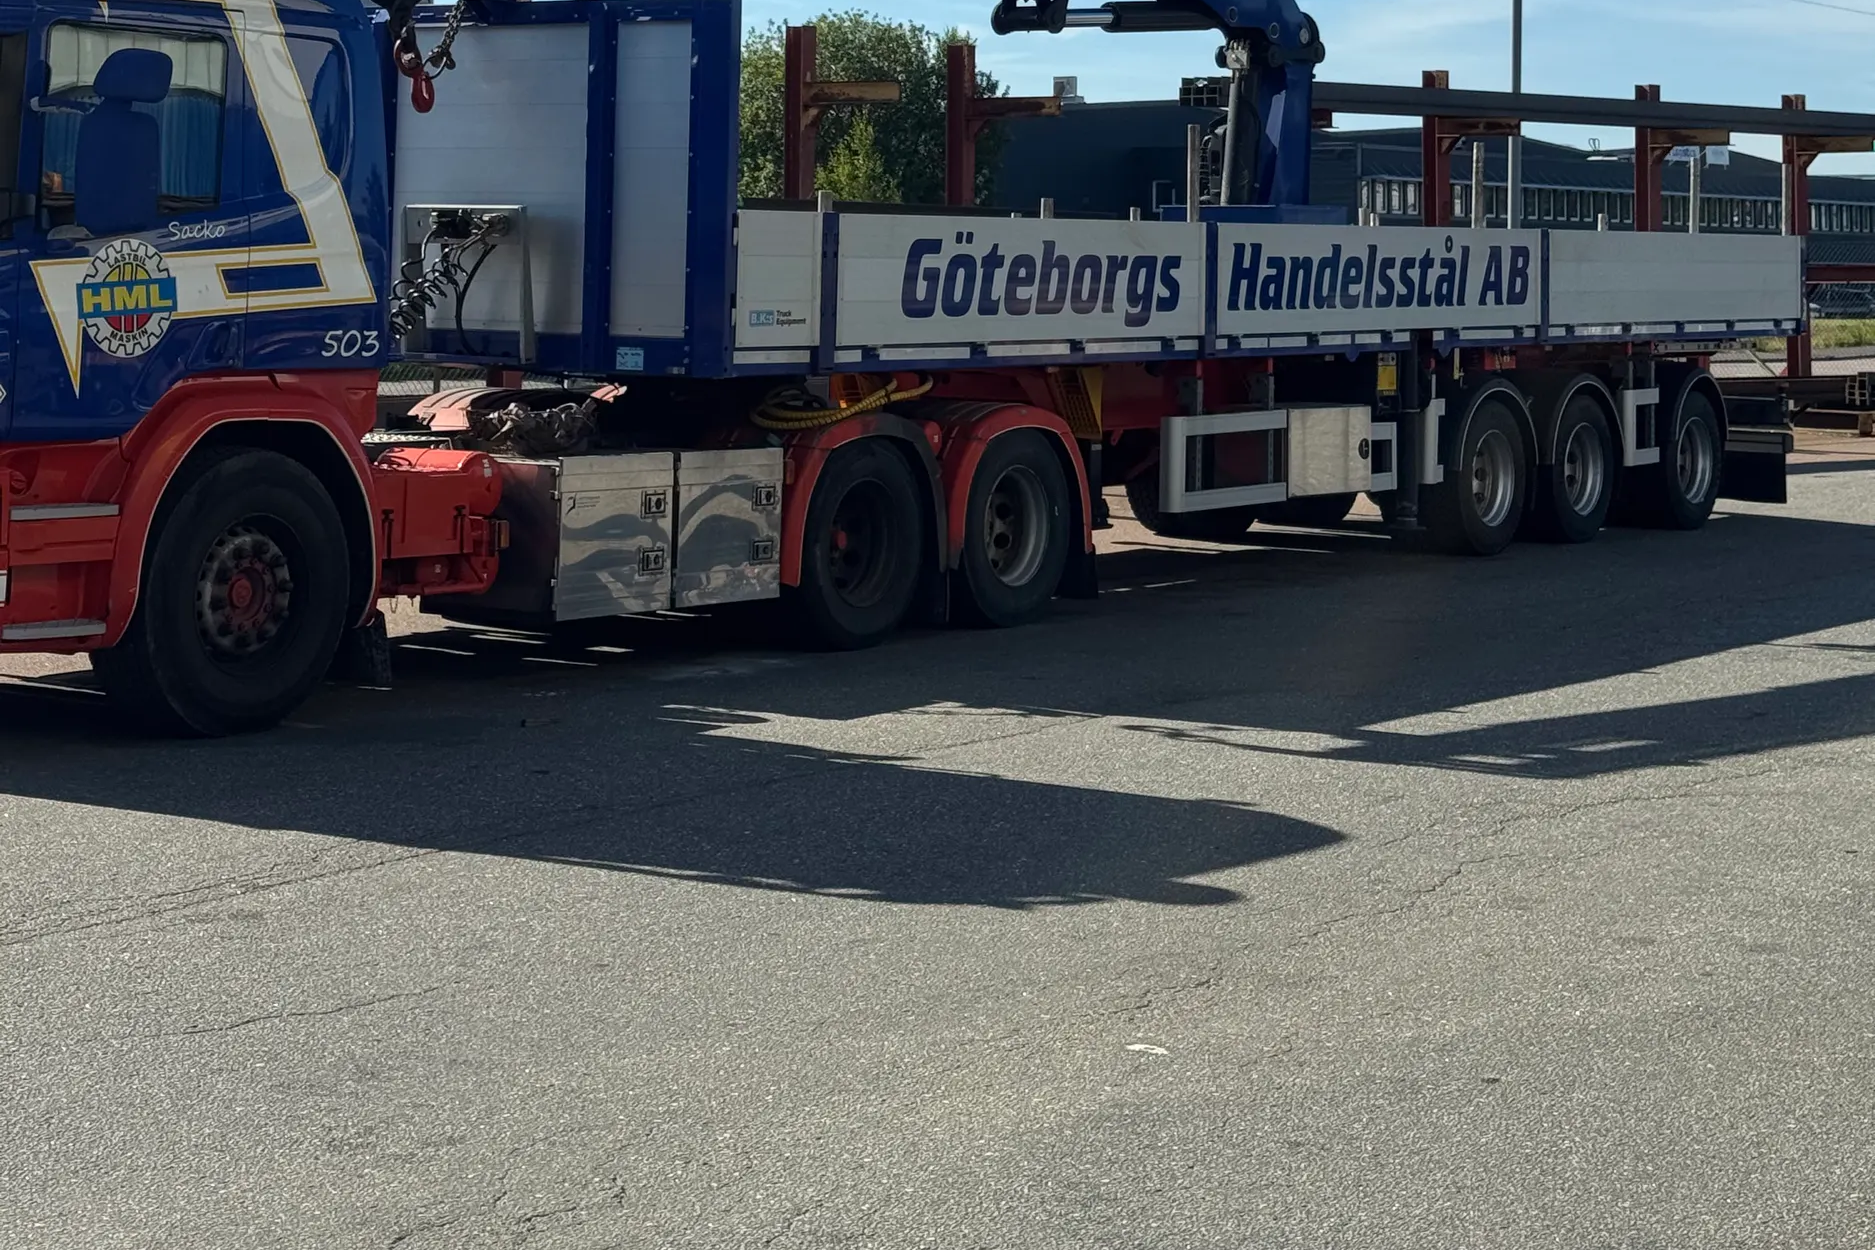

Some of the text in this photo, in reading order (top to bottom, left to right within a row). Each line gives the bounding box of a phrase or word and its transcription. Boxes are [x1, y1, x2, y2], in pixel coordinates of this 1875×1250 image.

[168, 219, 226, 241] Sacko
[107, 252, 147, 269] LASTBIL
[901, 231, 1530, 328] Göteborgs Handelsstål AB
[81, 283, 173, 313] HML
[109, 327, 148, 343] MASKIN
[321, 330, 380, 357] 503
